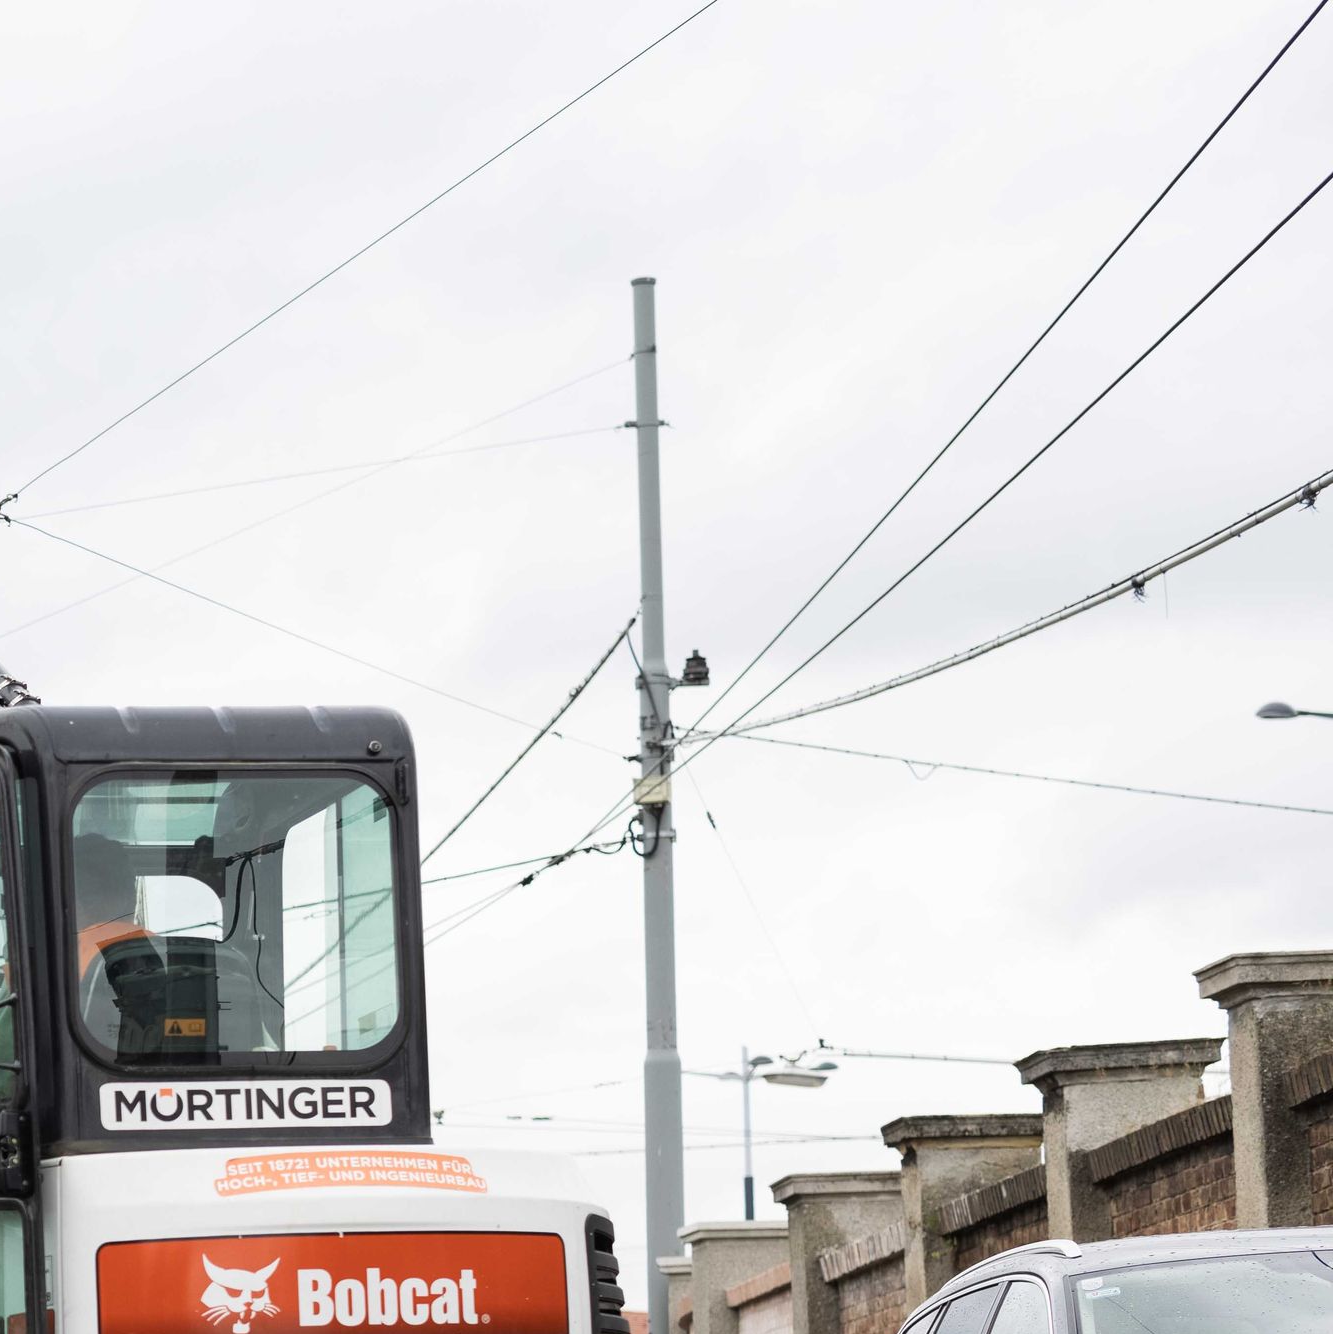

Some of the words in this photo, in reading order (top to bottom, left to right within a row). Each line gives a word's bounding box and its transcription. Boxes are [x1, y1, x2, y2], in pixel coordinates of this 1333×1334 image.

[227, 1162, 264, 1176] SEIT
[268, 1158, 310, 1172] 1872!
[315, 1156, 438, 1170] UNTERNEHMEN
[442, 1160, 472, 1174] FÜR
[280, 1171, 325, 1184] TIEF-
[329, 1170, 365, 1181] UND
[370, 1170, 486, 1189] INGENIEURBAU
